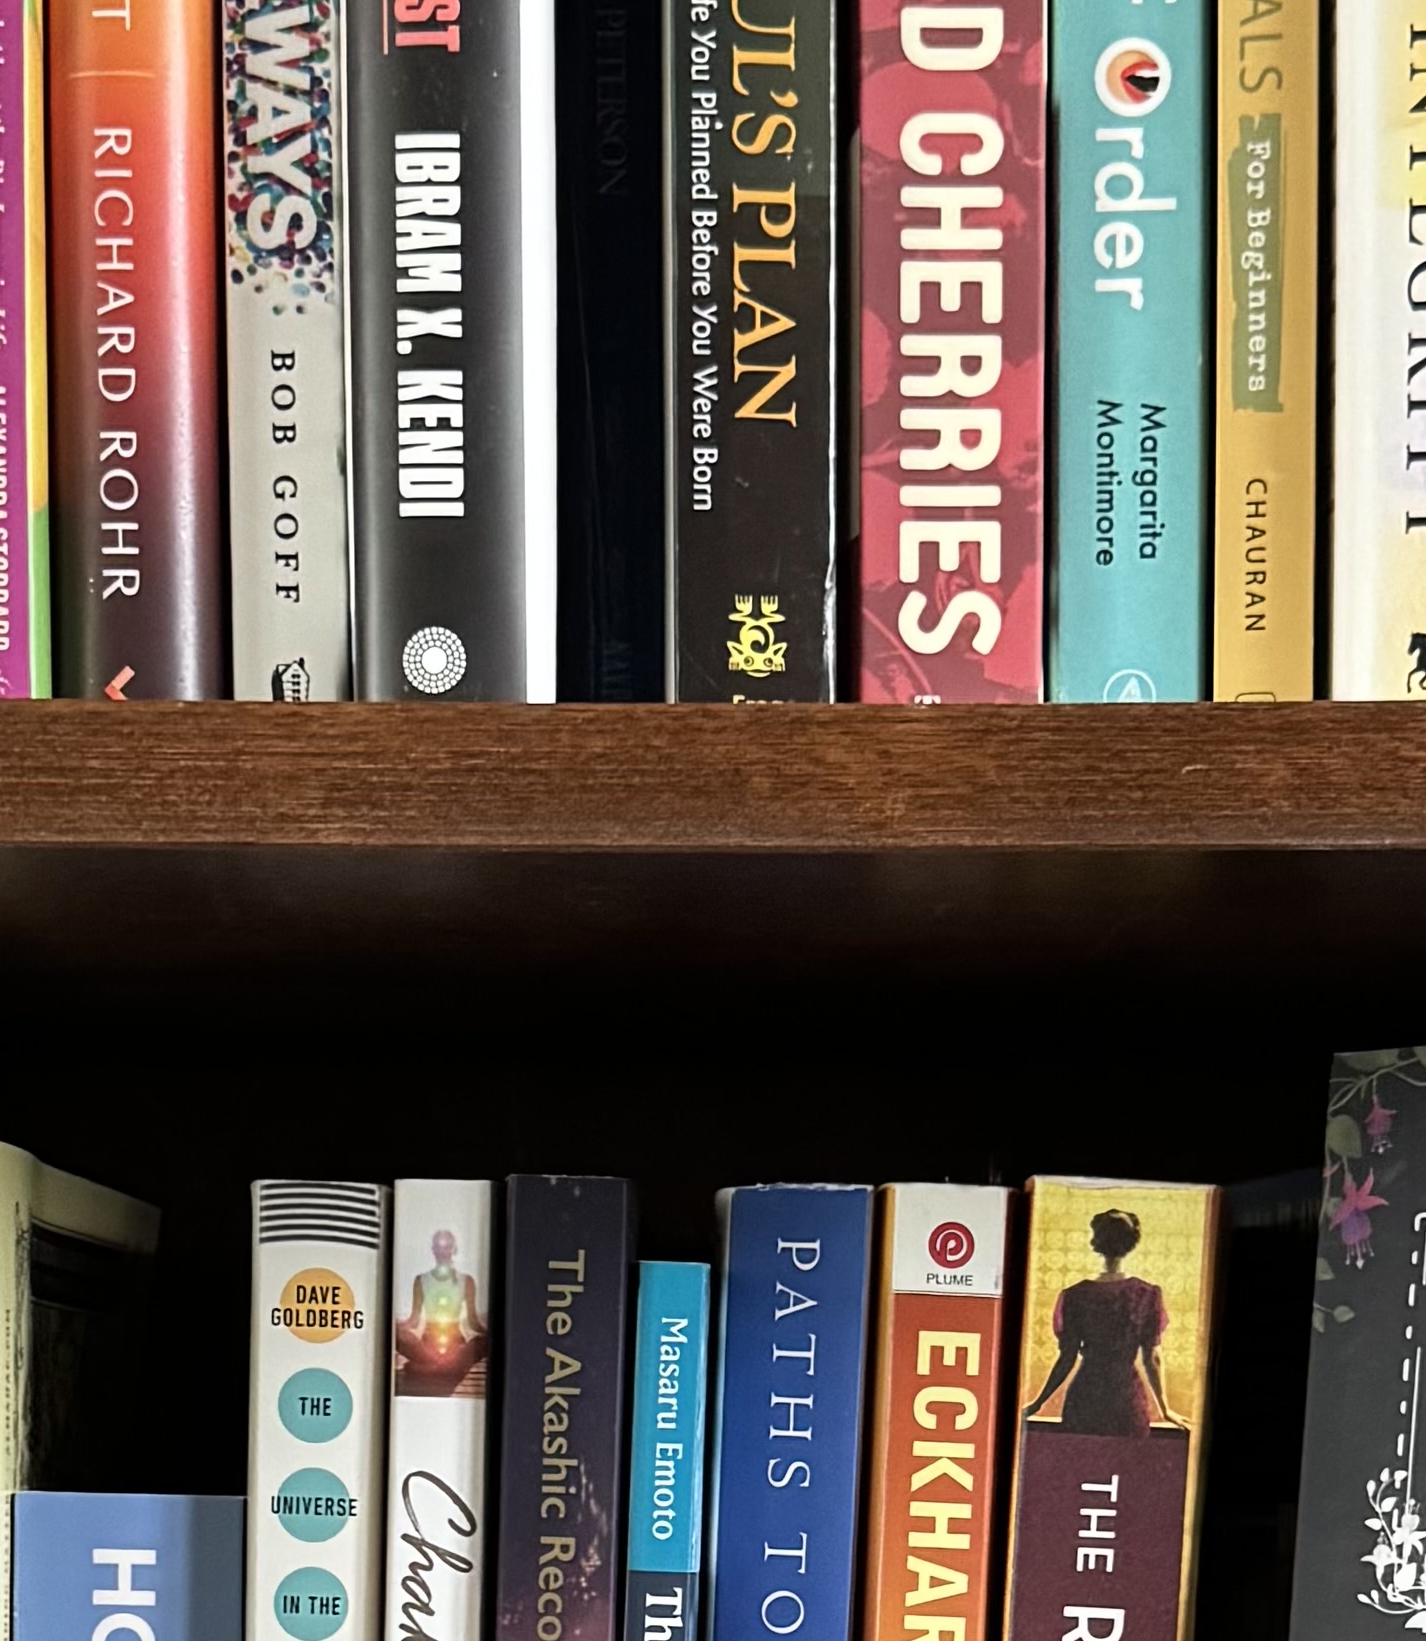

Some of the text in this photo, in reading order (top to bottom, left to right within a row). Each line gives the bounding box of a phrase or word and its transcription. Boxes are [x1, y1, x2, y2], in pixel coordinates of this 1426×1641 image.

[394, 132, 465, 518] IBRAM X. KENDI
[1241, 141, 1273, 393] For Beginners
[93, 126, 140, 600] RICHARD ROHR
[271, 350, 301, 604] BOB GOFF
[1095, 399, 1124, 566] Montimore
[1132, 403, 1167, 561] Margarita
[1245, 478, 1268, 633] CHAURAN
[271, 1307, 364, 1330] GOLDBERG
[296, 1285, 341, 1305] DAVE
[766, 1238, 821, 1489] PATHS
[299, 1397, 332, 1417] THE
[651, 1317, 689, 1541] Masaru Emoto
[271, 1495, 358, 1518] UNIVERSE
[761, 1532, 808, 1635] TO
[1076, 1475, 1119, 1573] THE
[282, 1595, 341, 1615] IN THE
